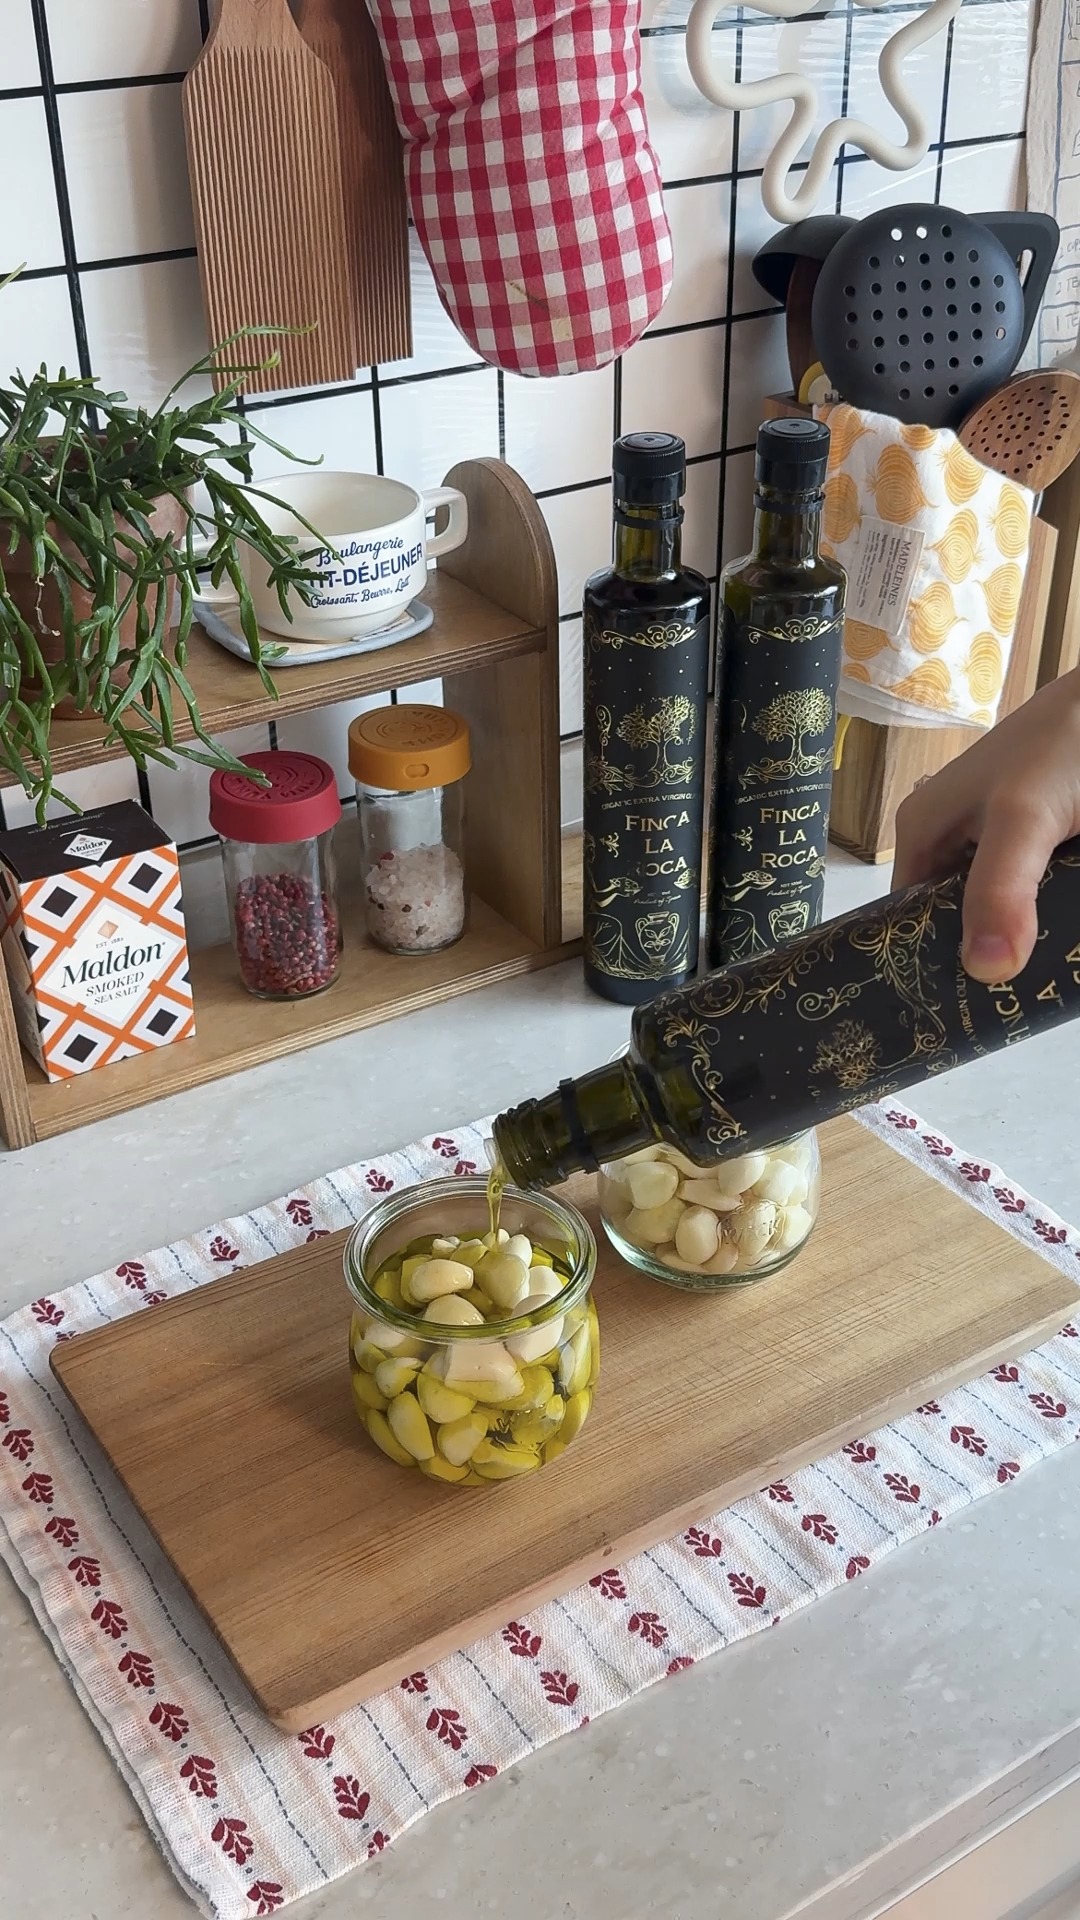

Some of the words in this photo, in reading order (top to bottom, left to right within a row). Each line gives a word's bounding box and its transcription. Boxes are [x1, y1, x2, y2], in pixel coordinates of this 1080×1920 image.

[316, 537, 404, 568] Boulangerie
[887, 541, 911, 606] MADELEINES
[625, 810, 690, 832] FINCA
[760, 801, 821, 824] FINCA
[69, 840, 108, 855] Maldon
[644, 838, 675, 854] LA
[779, 828, 807, 846] LA
[635, 856, 688, 876] OCA
[761, 845, 819, 869] ROCA
[61, 942, 163, 989] Maldon
[86, 971, 145, 998] SMOKED
[94, 994, 114, 1006] SEA
[114, 985, 140, 1002] SALT
